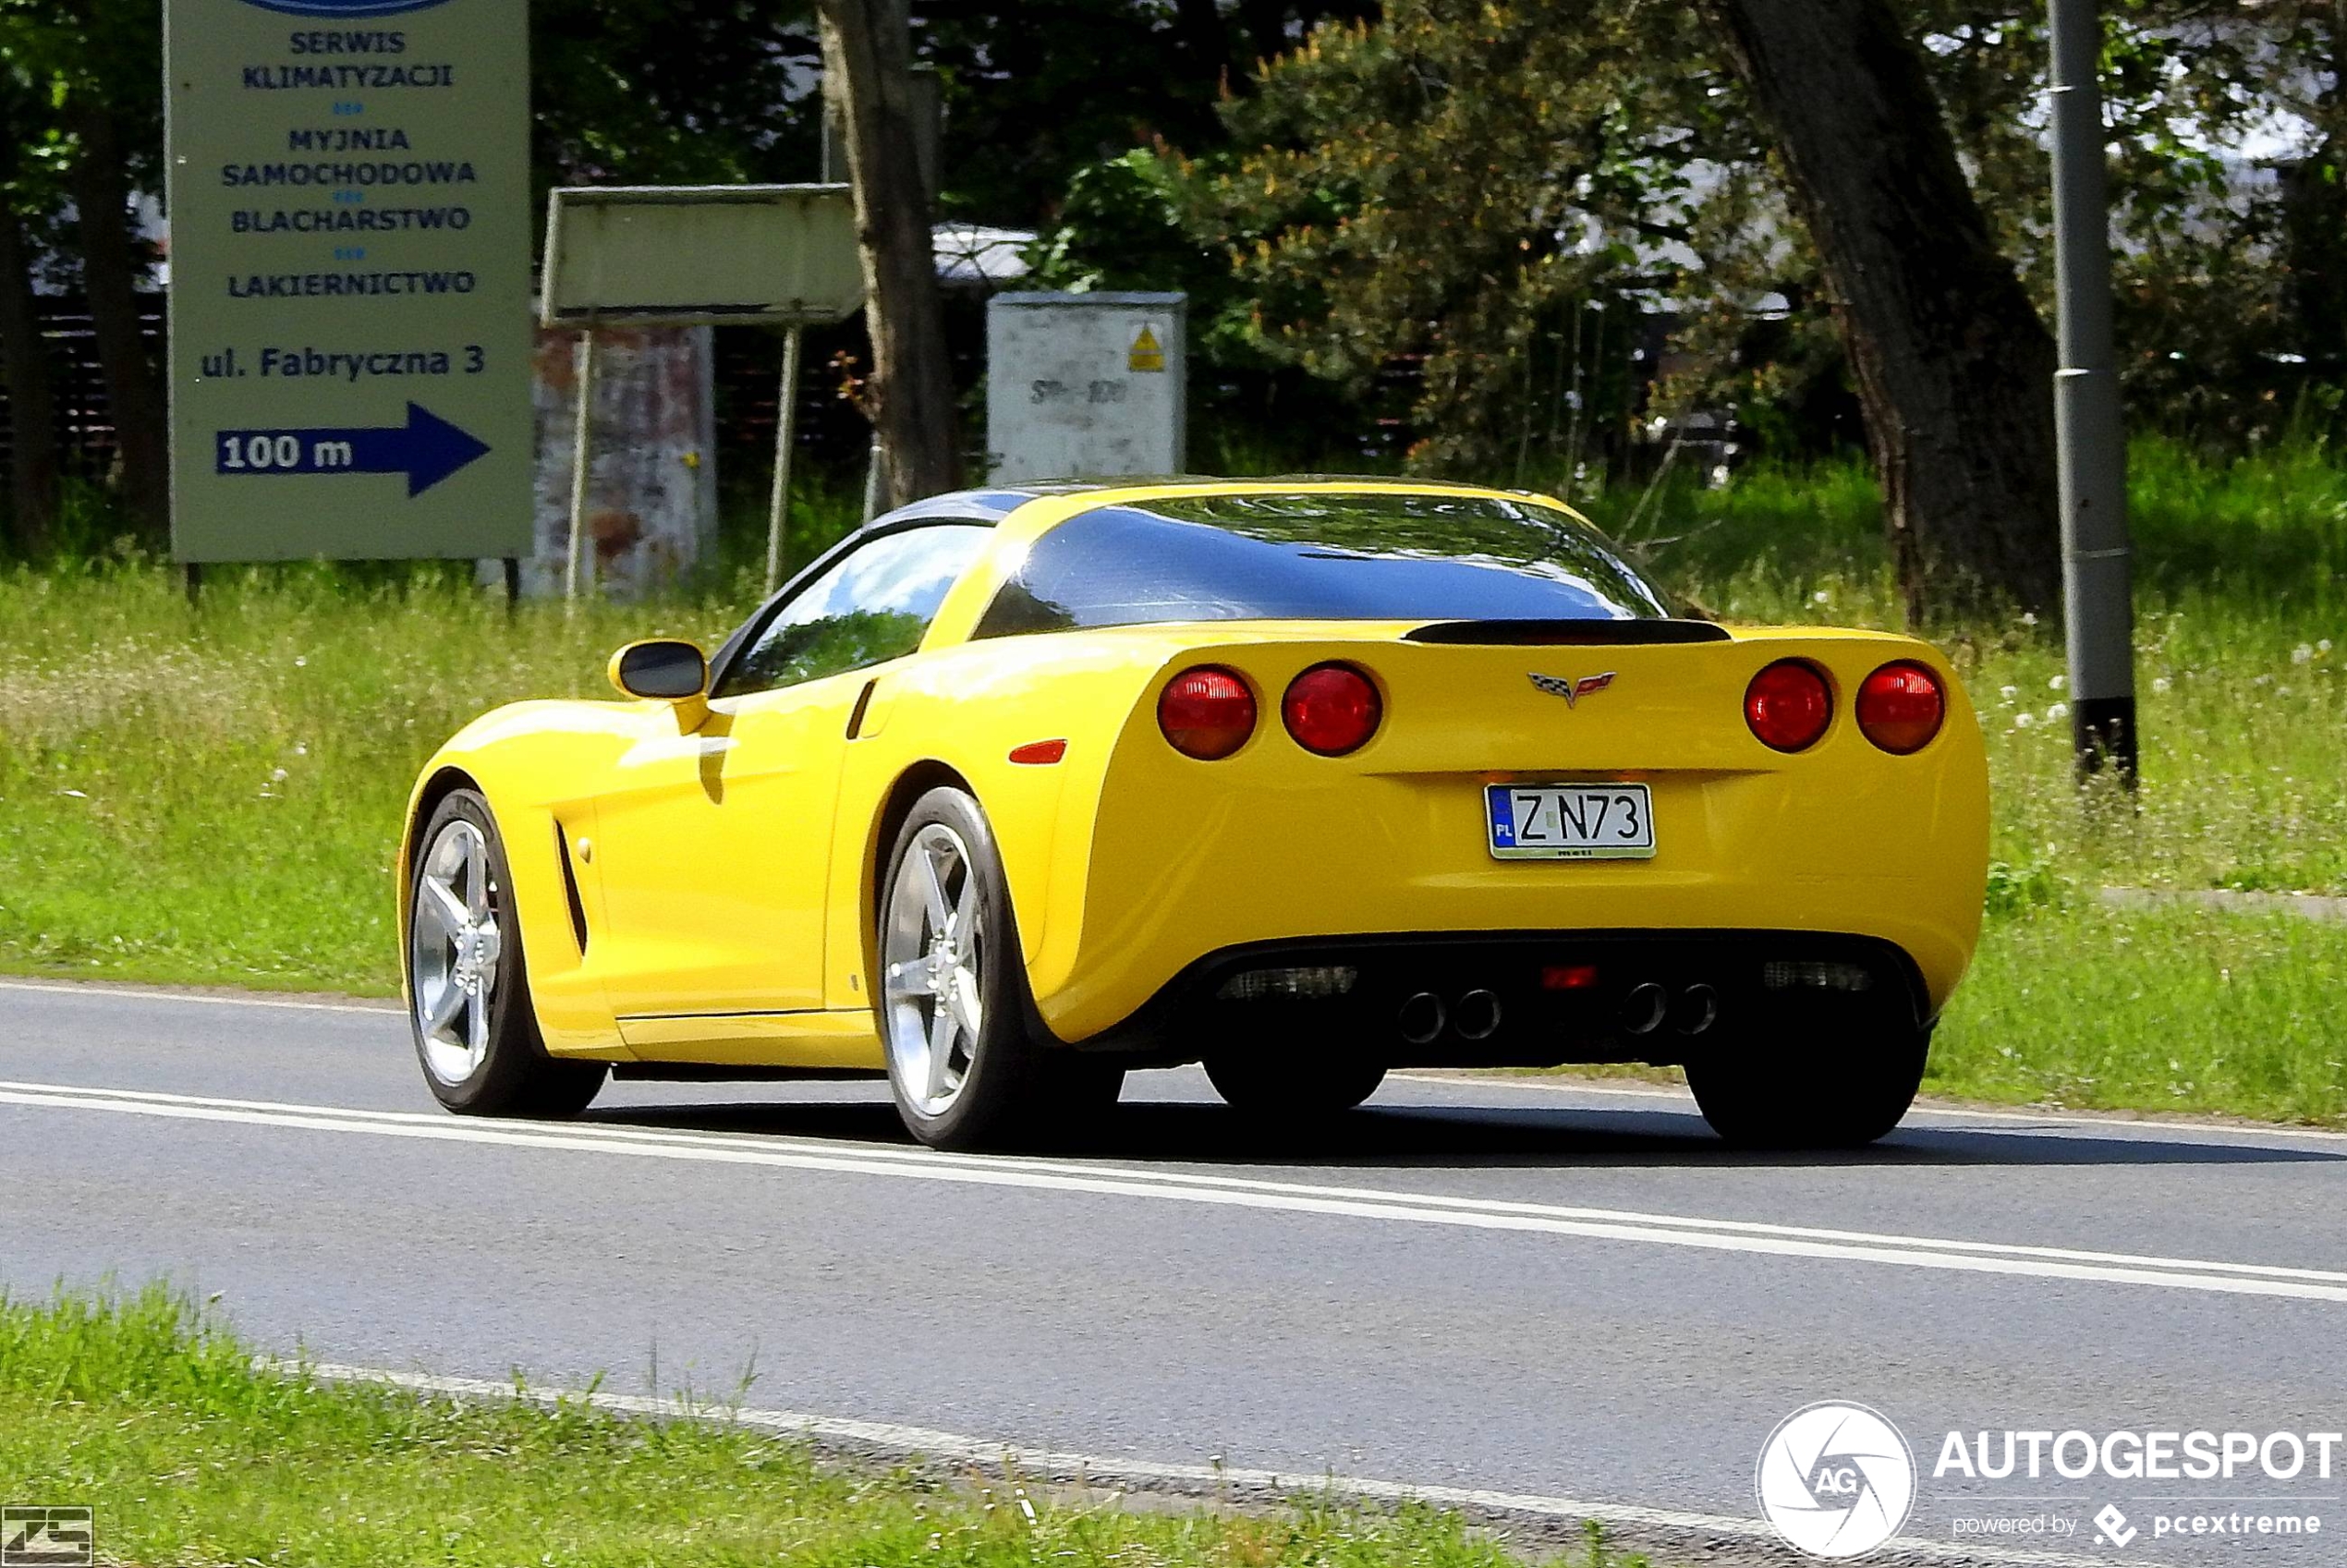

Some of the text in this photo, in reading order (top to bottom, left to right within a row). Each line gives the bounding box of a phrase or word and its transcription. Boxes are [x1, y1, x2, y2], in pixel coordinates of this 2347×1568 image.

[290, 31, 407, 55] SERWIS
[242, 65, 454, 89] KLIMATYZACJI
[288, 129, 409, 152] MYJNIA
[222, 162, 476, 187] SAMOCHODOWA
[232, 207, 470, 233] BLACHARSTWO
[227, 271, 476, 298] LAKIERNICTWO
[202, 345, 485, 383] ul. Fabryczna 3
[222, 435, 353, 469] 100 m
[1496, 823, 1514, 837] PL
[1516, 795, 1639, 840] Z N73
